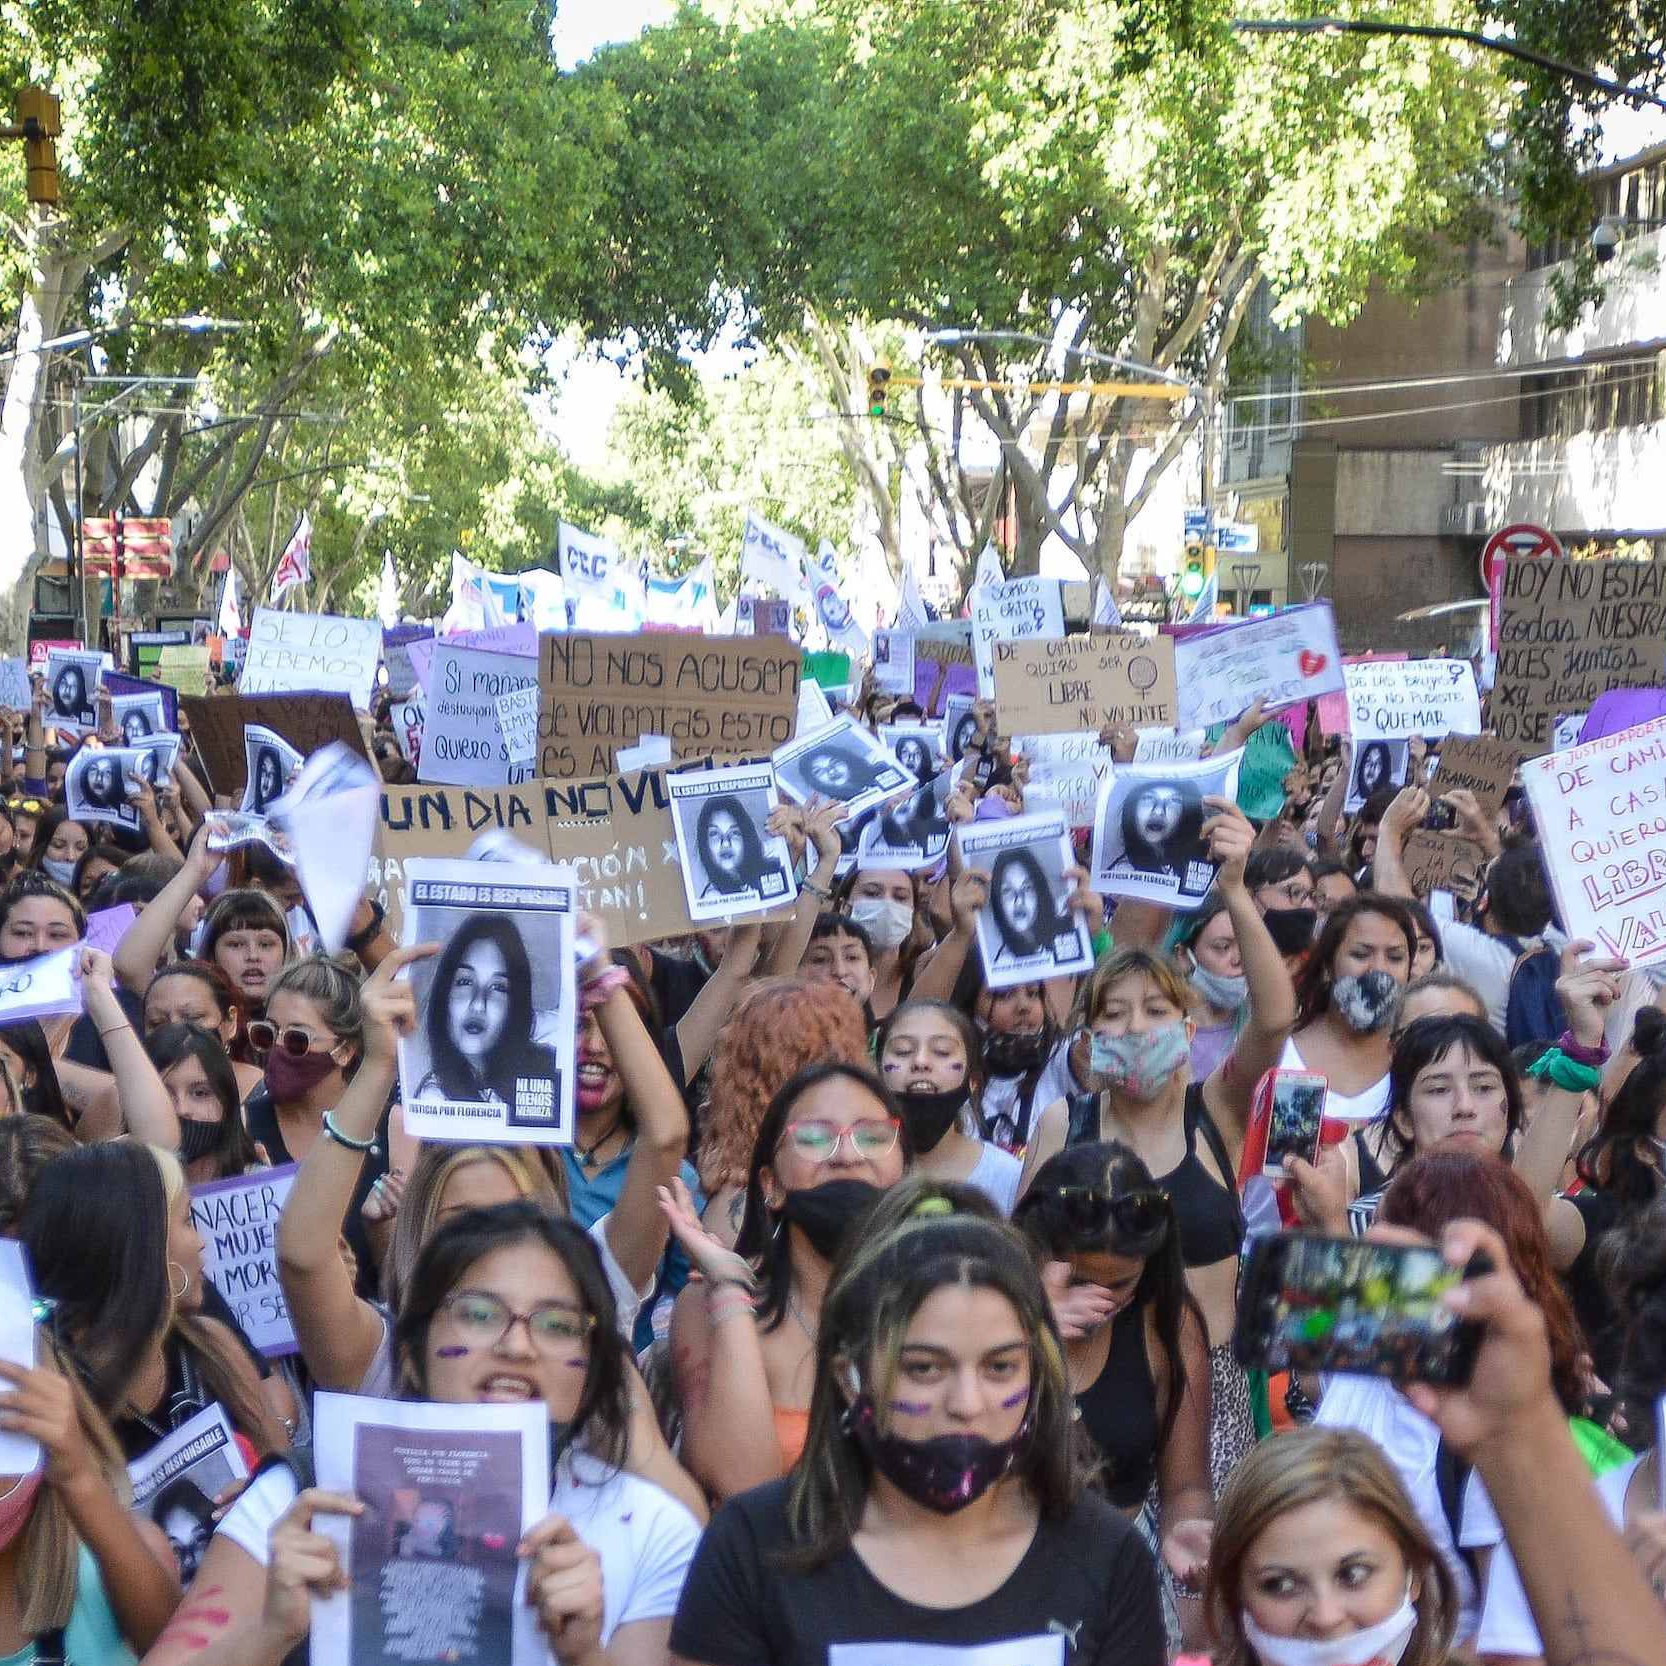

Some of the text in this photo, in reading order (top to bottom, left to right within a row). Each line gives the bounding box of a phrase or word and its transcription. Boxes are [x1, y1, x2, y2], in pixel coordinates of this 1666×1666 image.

[1503, 561, 1553, 602] HOY
[1560, 561, 1594, 599] NO
[260, 618, 291, 644] SE
[247, 647, 364, 678] DEBEMOS
[550, 637, 663, 689] NO NOS
[998, 643, 1019, 662] DE
[1375, 707, 1447, 732] QUEMAR
[1557, 765, 1593, 794] DE
[380, 786, 612, 831] UN DIA NO
[1568, 808, 1584, 831] A
[428, 884, 475, 902] ESTADO
[516, 1078, 552, 1094] NI UNA
[516, 1091, 553, 1107] MENOS
[440, 1105, 456, 1116] POR
[457, 1106, 502, 1119] FLORENCIA
[189, 1185, 281, 1232] NACER
